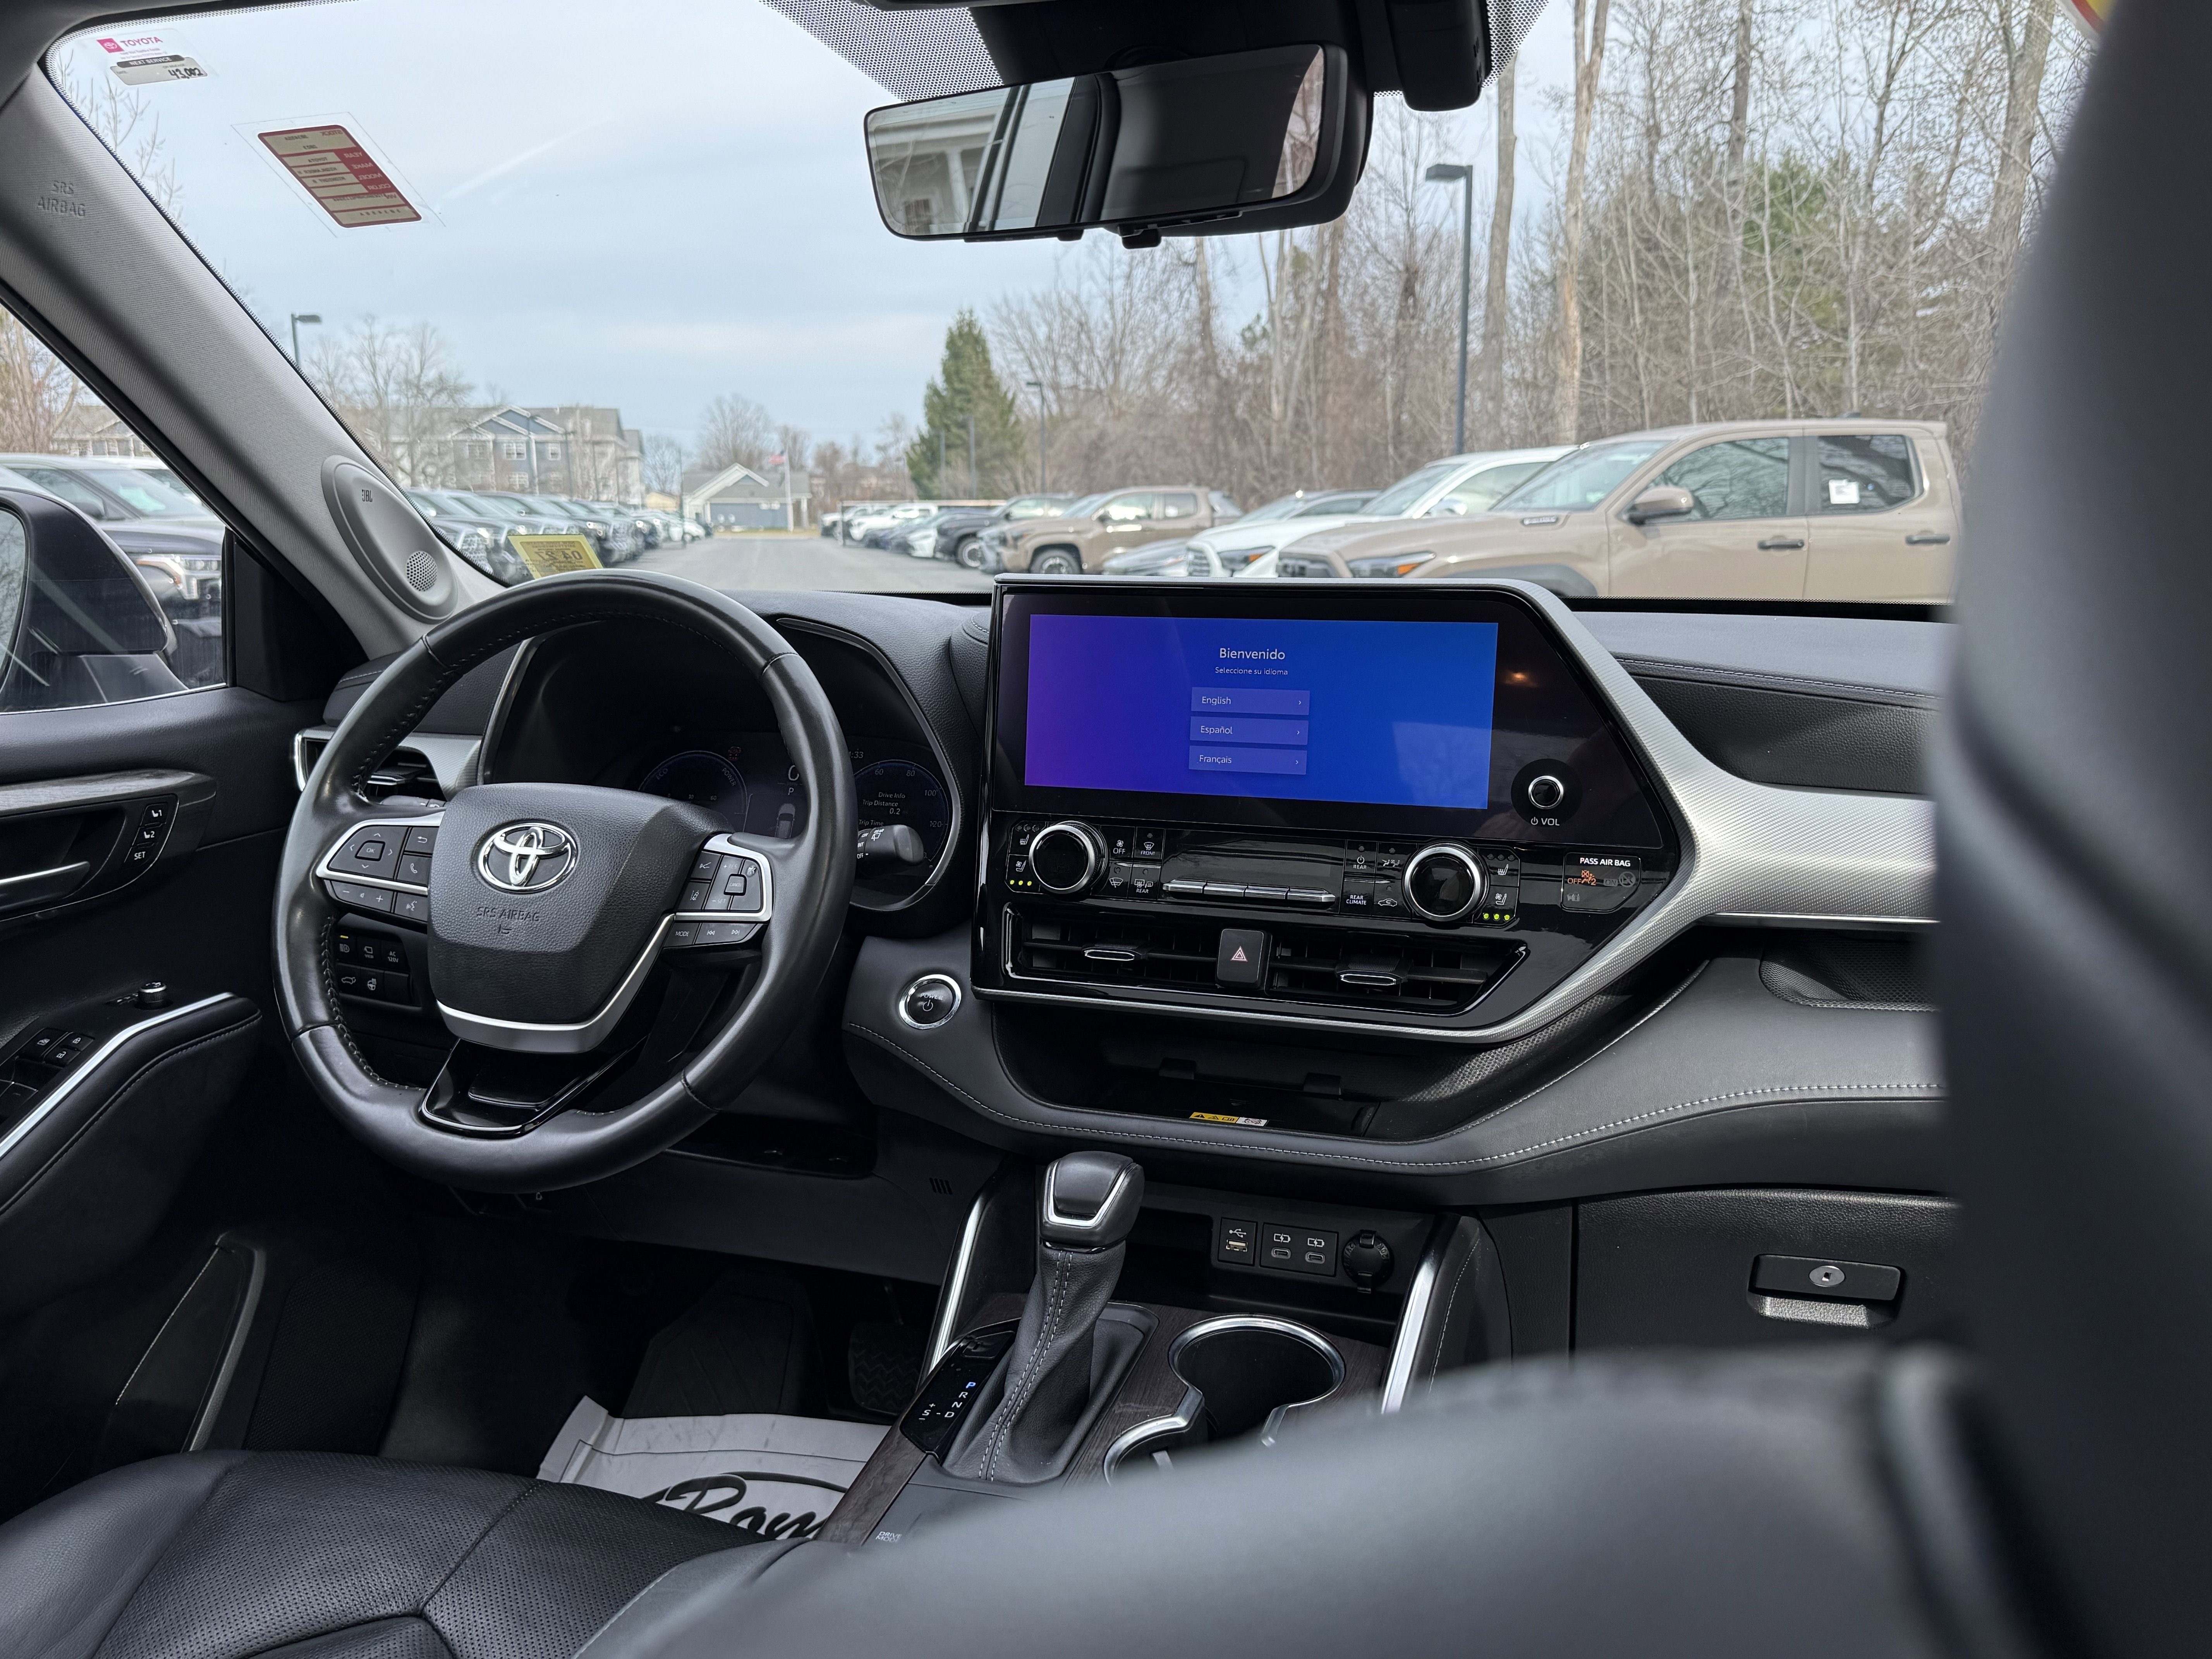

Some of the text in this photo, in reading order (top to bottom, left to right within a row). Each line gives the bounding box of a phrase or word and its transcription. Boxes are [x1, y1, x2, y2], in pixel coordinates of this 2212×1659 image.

[120, 37, 163, 47] TOYOTA
[37, 197, 85, 216] AIRBAG
[362, 489, 373, 502] JBL
[1219, 648, 1286, 659] Bienvenido
[1202, 696, 1231, 706] English
[1200, 725, 1233, 735] Español
[1199, 755, 1232, 764] Français
[656, 768, 668, 780] ECO
[722, 767, 736, 787] POWER
[788, 787, 794, 796] P
[134, 851, 146, 860] SET
[476, 907, 540, 922] SRS AIRBAG
